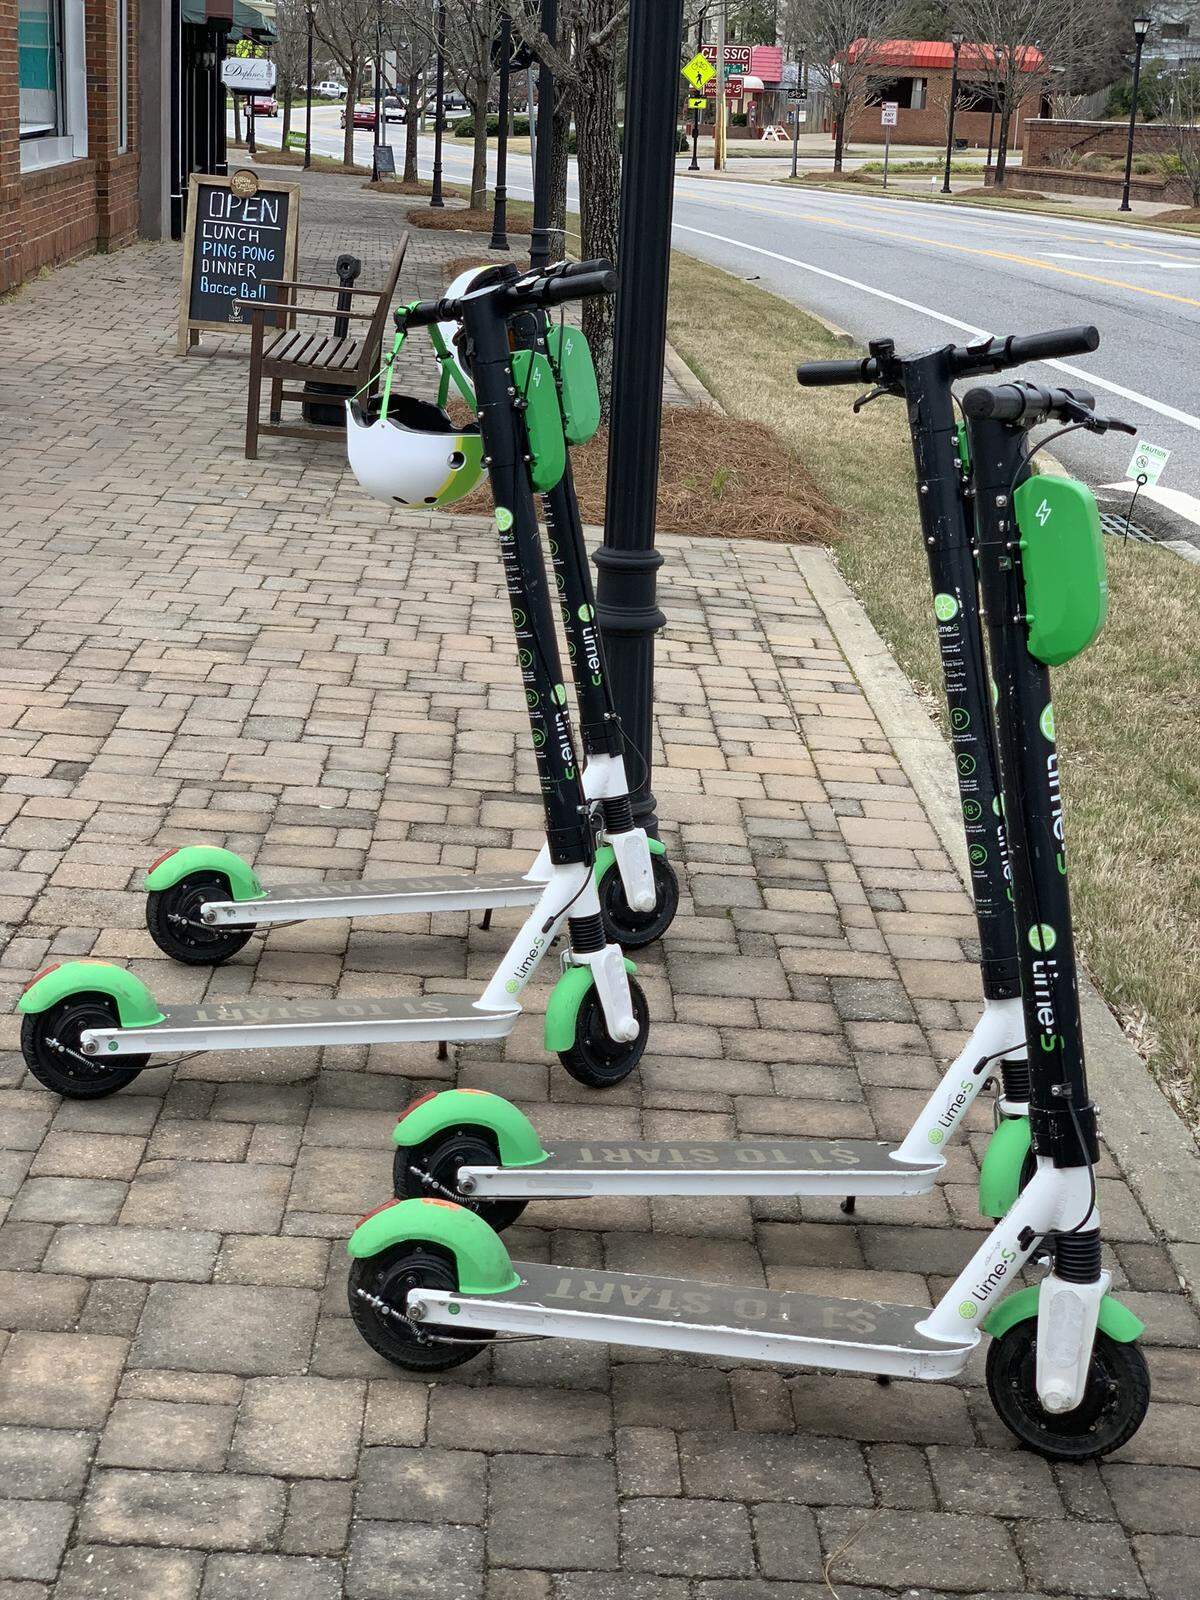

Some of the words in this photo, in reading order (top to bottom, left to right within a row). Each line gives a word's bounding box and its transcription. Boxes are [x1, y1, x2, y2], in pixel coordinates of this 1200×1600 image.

[701, 48, 750, 60] CLSSIC
[210, 191, 279, 223] OPEN
[203, 223, 259, 243] LUNCH
[202, 259, 257, 279] DINNER
[201, 276, 237, 296] Bocce
[241, 282, 266, 300] Ball
[1141, 444, 1167, 458] CAUTION
[963, 804, 978, 816] 18+
[193, 1006, 323, 1025] START
[337, 1003, 391, 1016] TO
[577, 1147, 720, 1166] START
[735, 1148, 797, 1164] TO
[809, 1147, 861, 1165] $1
[546, 1278, 713, 1315] START
[732, 1299, 791, 1323] TO
[818, 1306, 877, 1334] $1
